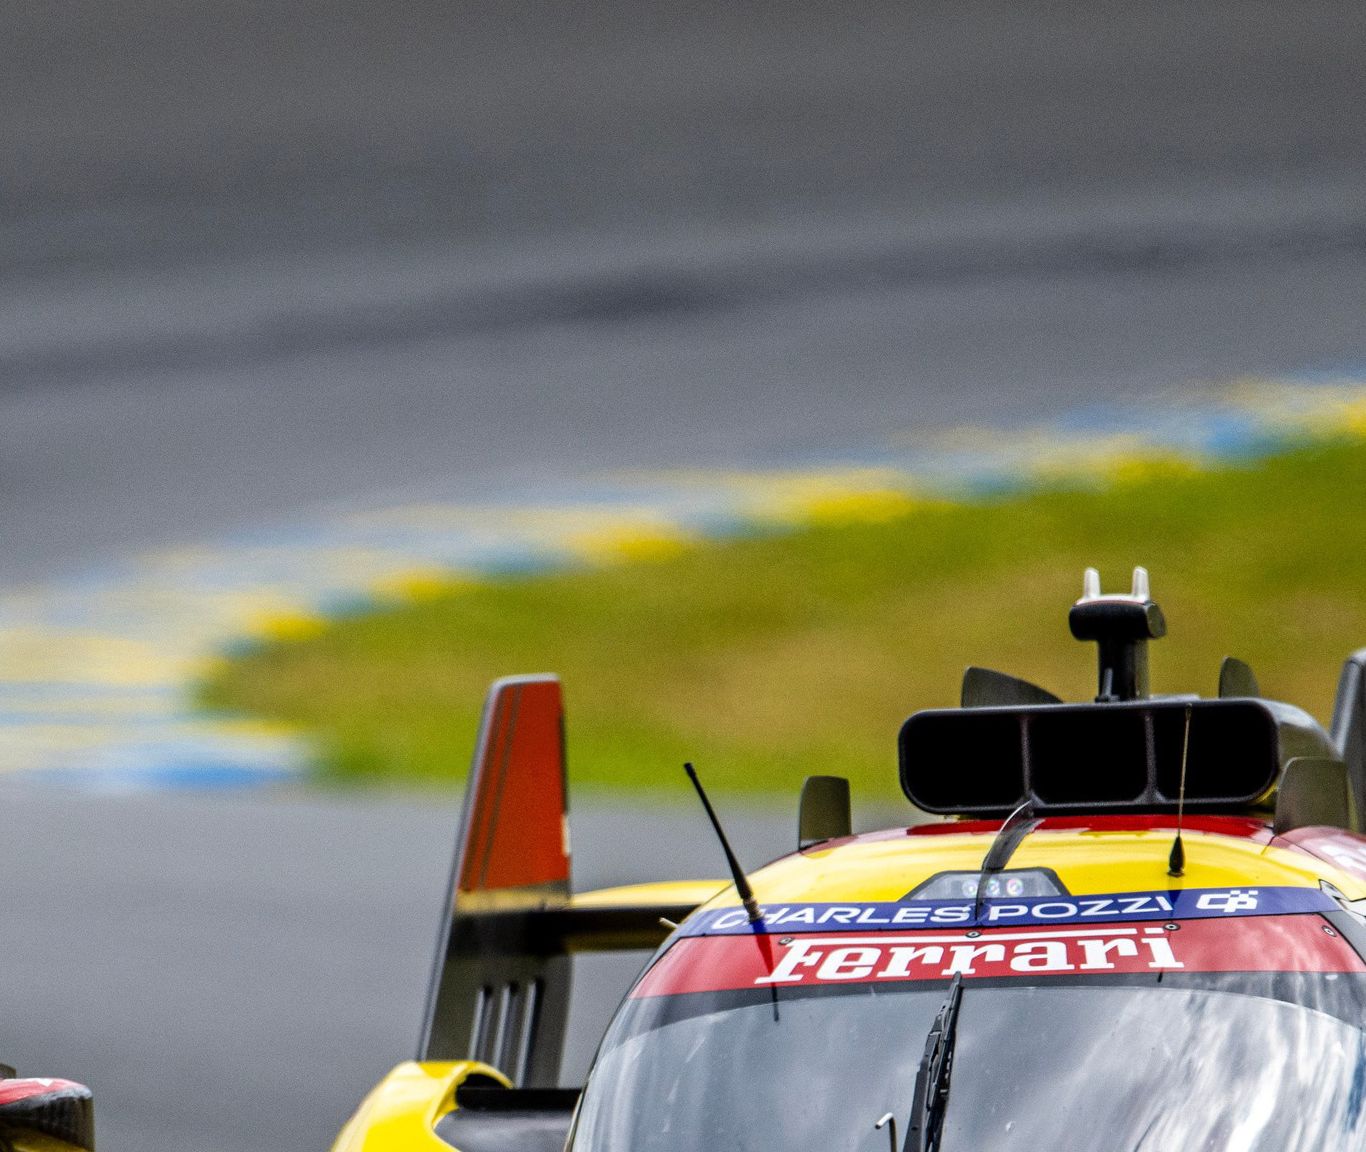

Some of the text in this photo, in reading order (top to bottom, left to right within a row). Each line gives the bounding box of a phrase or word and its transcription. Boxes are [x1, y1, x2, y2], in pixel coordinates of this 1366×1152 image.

[711, 896, 1174, 930] CHARLES POZZI
[754, 928, 1185, 984] Ferrari
